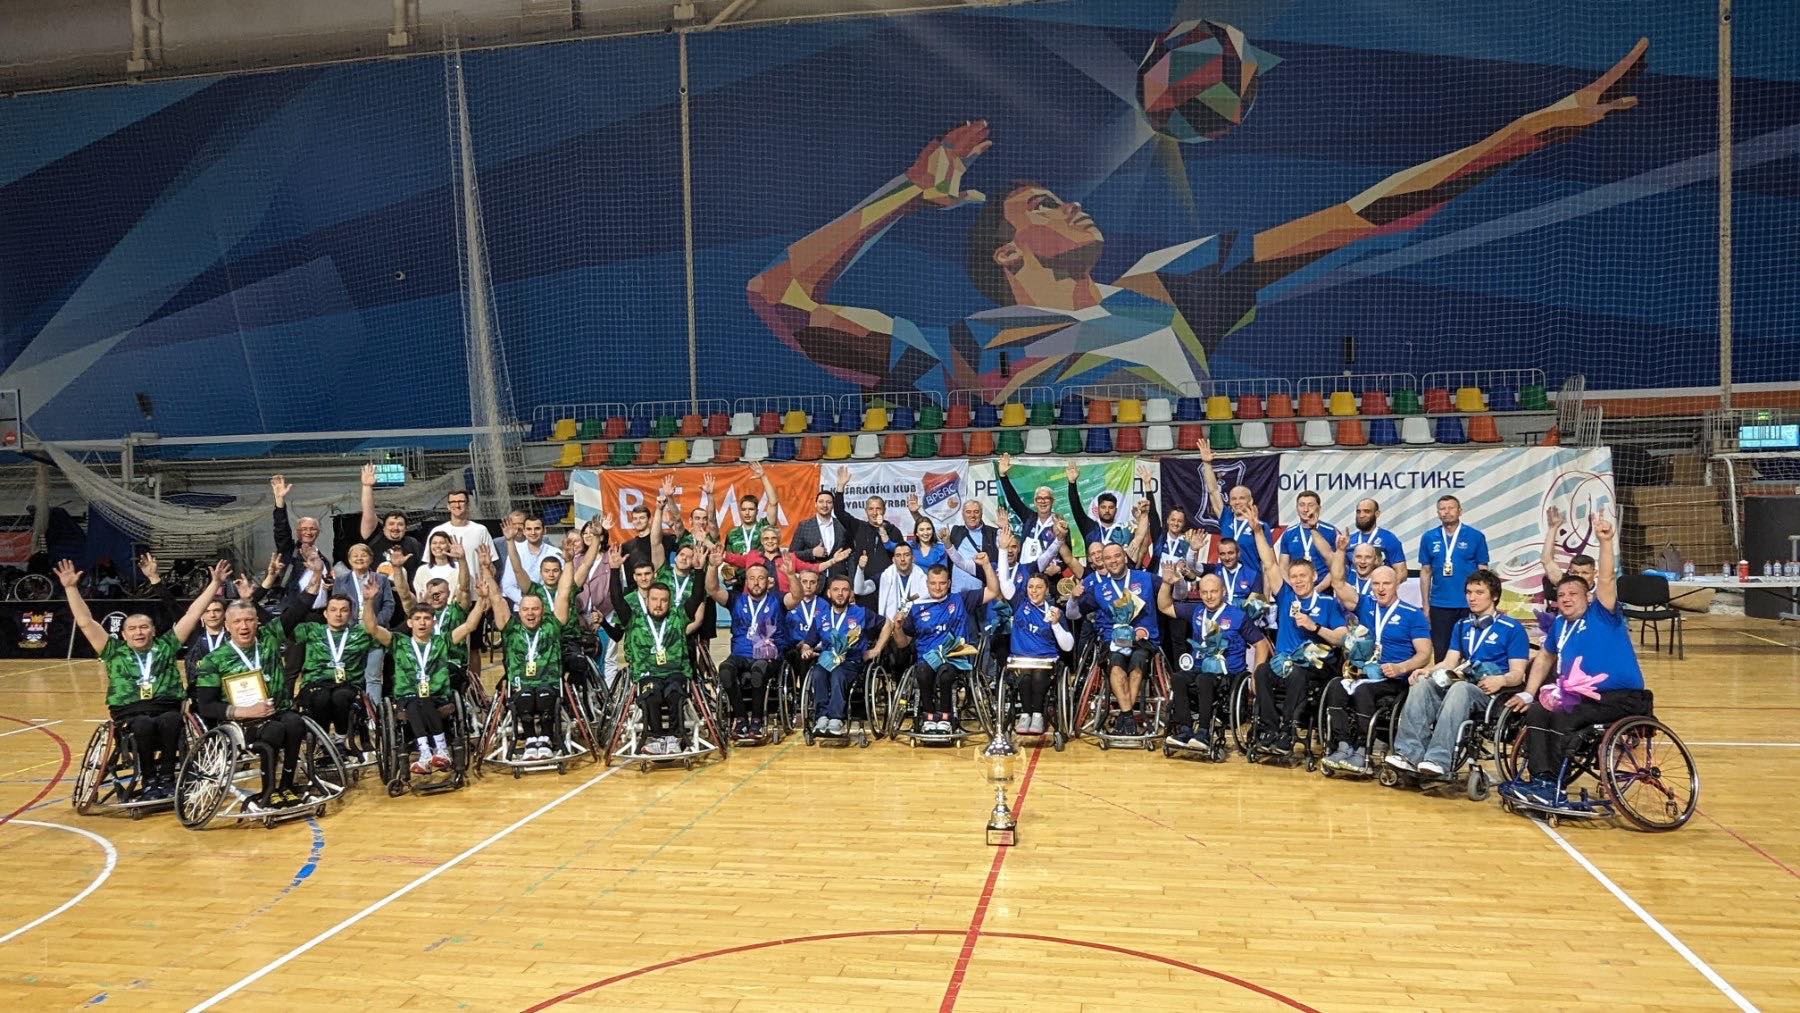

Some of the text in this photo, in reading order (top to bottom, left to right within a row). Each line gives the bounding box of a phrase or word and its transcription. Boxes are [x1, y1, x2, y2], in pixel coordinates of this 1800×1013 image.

[1316, 471, 1466, 491] ГИМНАСТИКЕ
[893, 484, 917, 494] KLUB
[926, 483, 956, 505] ВРБАС
[885, 498, 909, 508] VRBA
[1028, 623, 1039, 634] 17
